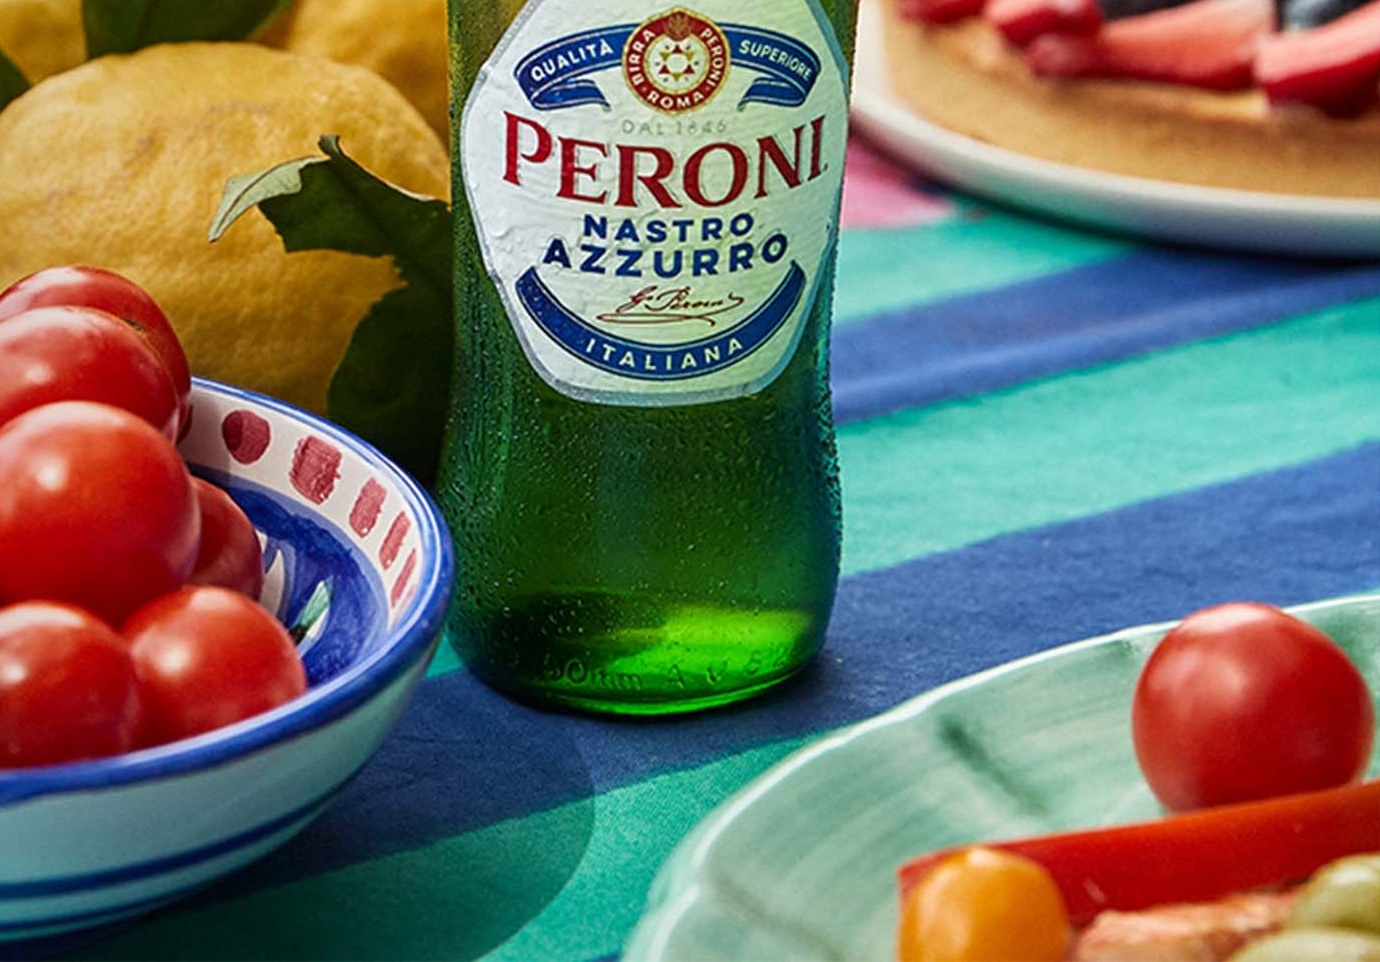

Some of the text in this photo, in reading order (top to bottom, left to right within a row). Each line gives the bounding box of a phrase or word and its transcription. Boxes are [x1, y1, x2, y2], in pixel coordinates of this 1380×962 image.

[530, 37, 813, 83] QUALITÀ SUPERIORE
[628, 27, 724, 87] BIRRA PERONI
[646, 90, 705, 110] ROMA
[621, 117, 728, 136] DAL 1846
[502, 110, 827, 211] PERONI
[583, 212, 755, 244] NASTRO
[542, 233, 789, 280] AZZURRO
[585, 338, 744, 372] ITALIANA
